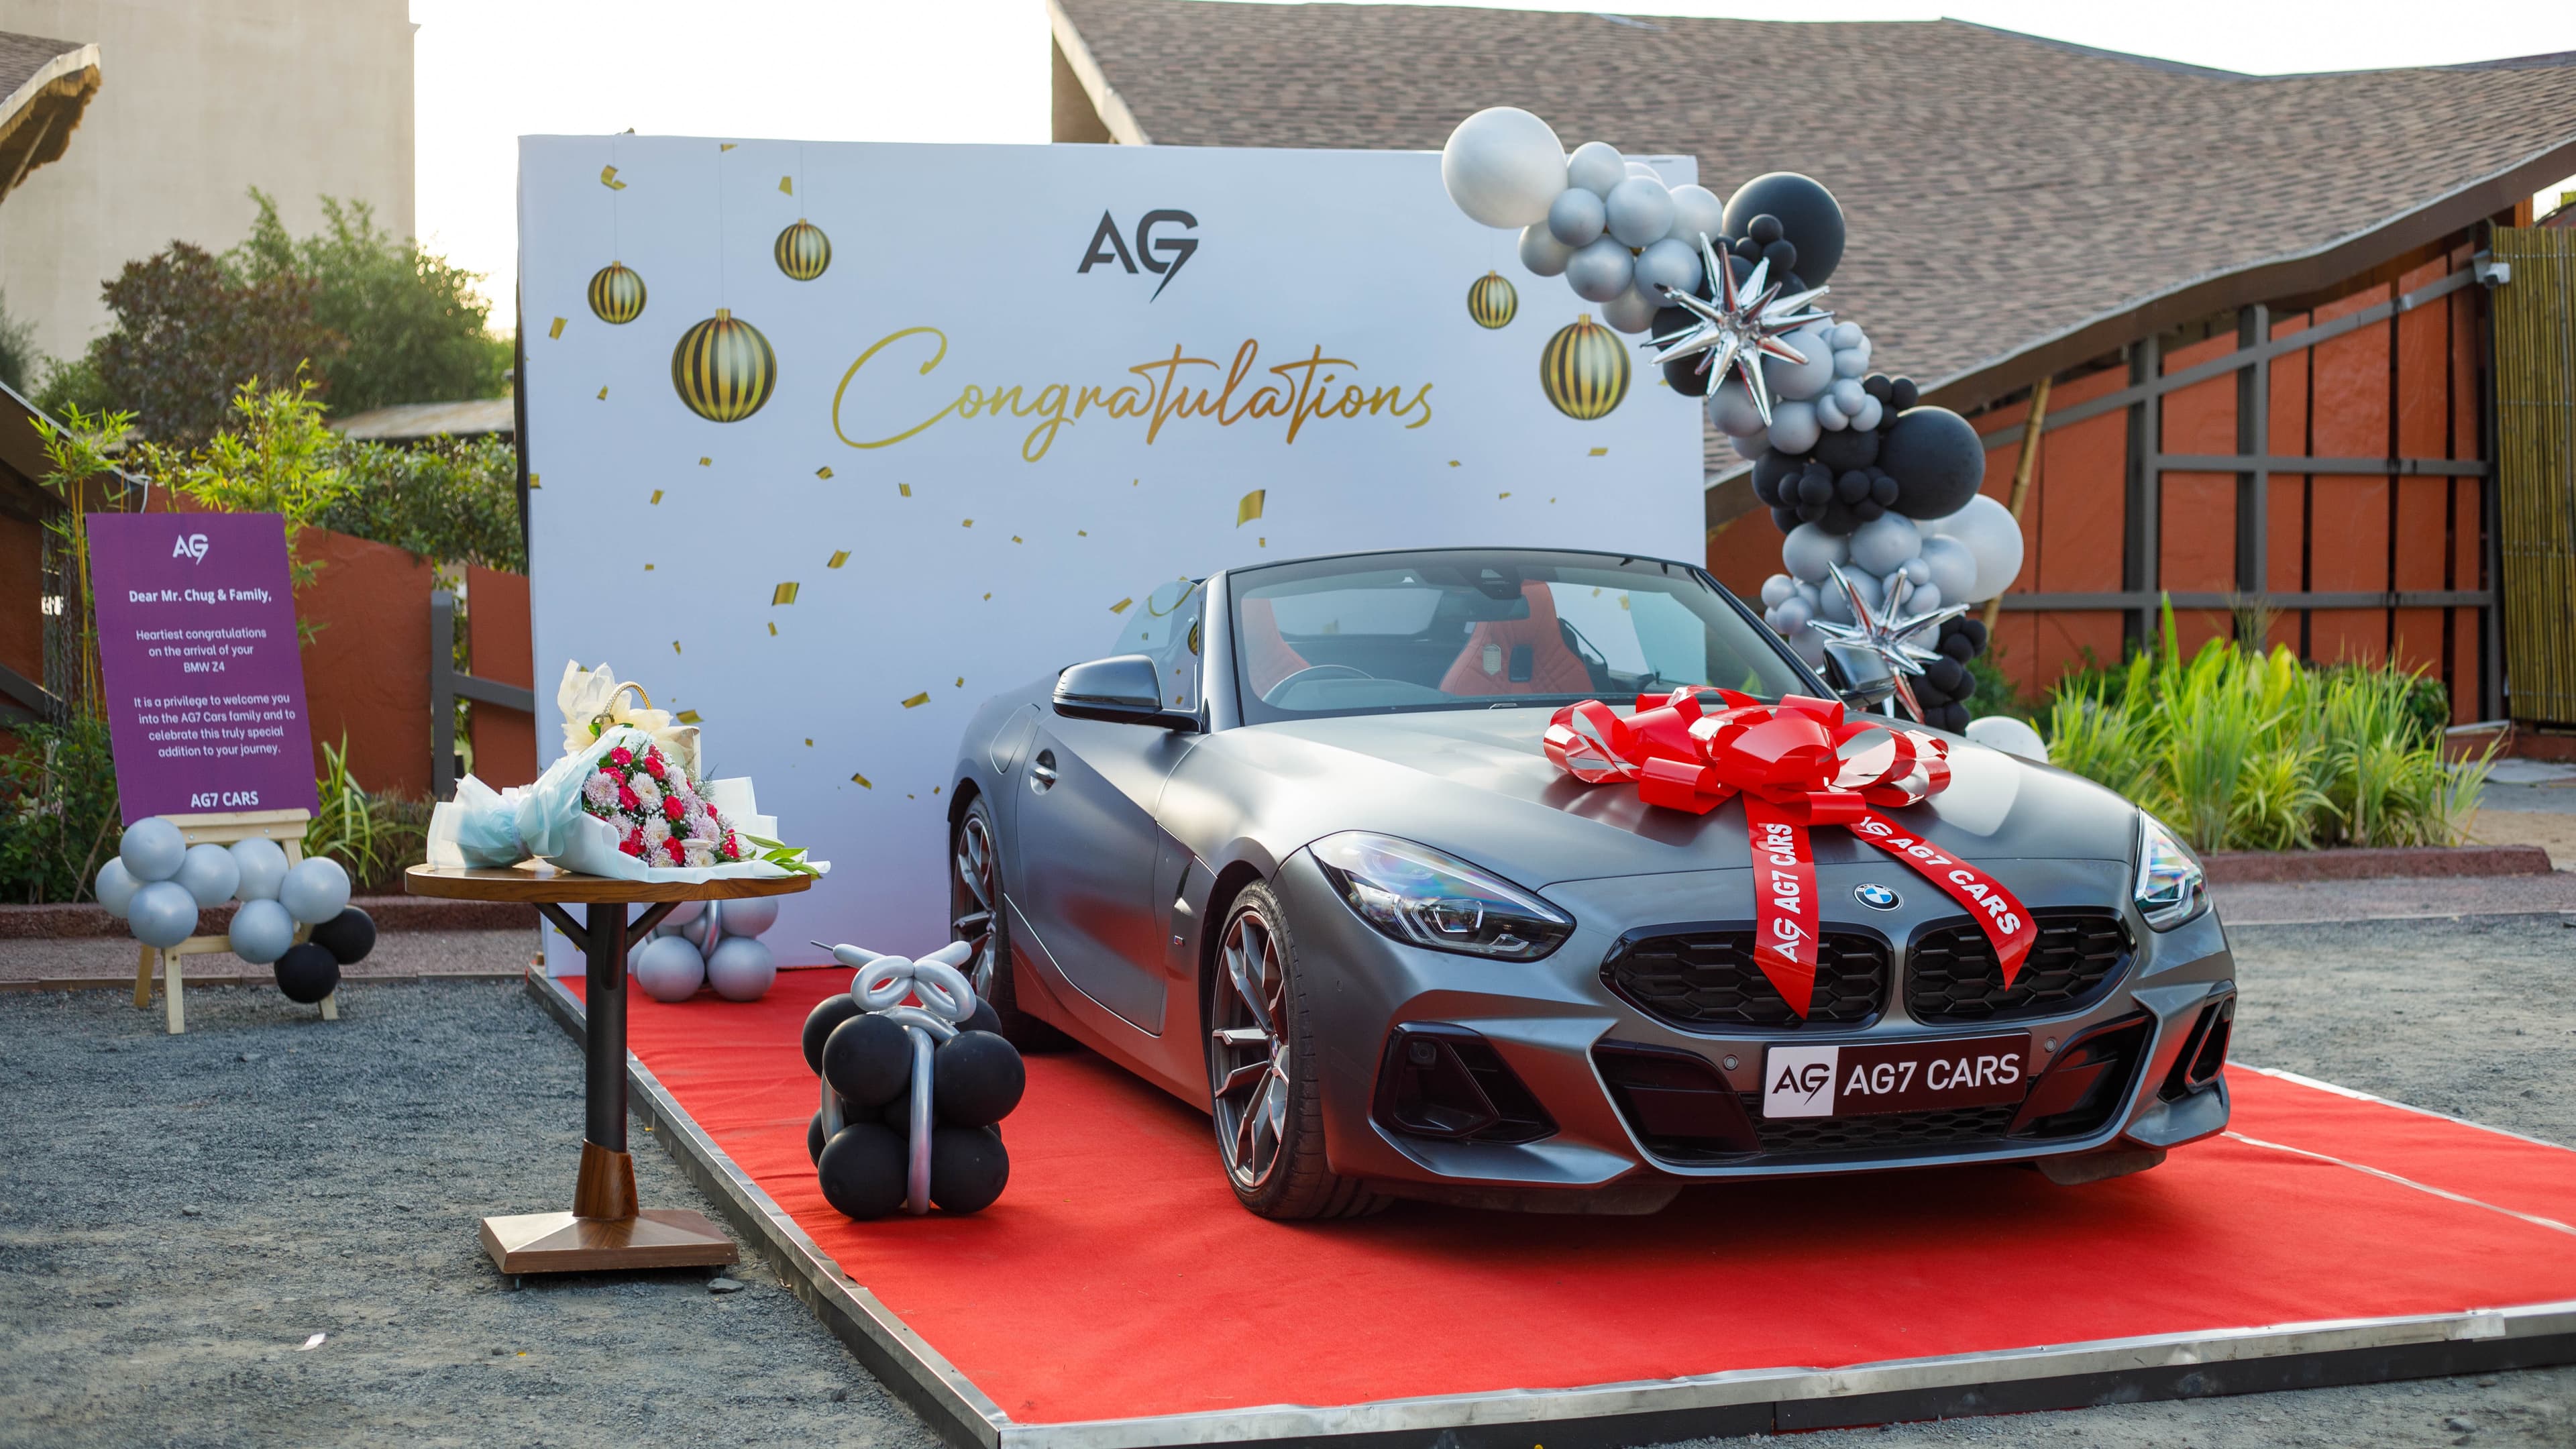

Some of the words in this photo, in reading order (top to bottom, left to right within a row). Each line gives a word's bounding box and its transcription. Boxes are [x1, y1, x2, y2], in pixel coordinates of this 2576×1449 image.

[832, 326, 1434, 463] Congratulations
[129, 590, 158, 602] Dear
[161, 589, 182, 602] Mr.
[184, 588, 215, 604] Chug
[217, 588, 227, 602] &
[229, 588, 272, 604] Family,
[136, 629, 183, 641] Heartiest
[185, 627, 267, 641] congratulations
[148, 648, 162, 657] on
[164, 645, 181, 657] the
[183, 645, 216, 656] arrival
[219, 644, 229, 655] of
[231, 645, 254, 657] your
[184, 661, 209, 673] BMW
[211, 661, 225, 672] Z4
[134, 697, 142, 708] It
[144, 696, 152, 707] is
[154, 698, 162, 707] a
[164, 695, 207, 708] privilege
[210, 695, 221, 706] to
[223, 694, 269, 704] welcome
[272, 694, 290, 706] you
[139, 713, 159, 724] into
[161, 712, 178, 724] the
[181, 712, 201, 723] AG7
[203, 711, 227, 722] Cars
[229, 710, 261, 722] family
[263, 709, 283, 720] and
[285, 708, 295, 720] to
[148, 729, 199, 741] celebrate
[201, 728, 219, 739] this
[222, 727, 245, 741] truly
[247, 725, 284, 740] special
[158, 745, 201, 757] addition
[203, 745, 214, 756] to
[216, 746, 238, 758] your
[240, 743, 281, 757] journey.
[191, 792, 219, 808] AG7
[223, 791, 259, 806] CARS
[1766, 823, 1796, 867] CARS
[1772, 871, 1801, 914] AG7
[1886, 838, 1952, 866] AG7
[1949, 869, 2021, 935] CARS
[1843, 1061, 1918, 1096] AG7
[1927, 1053, 2020, 1091] CARS
